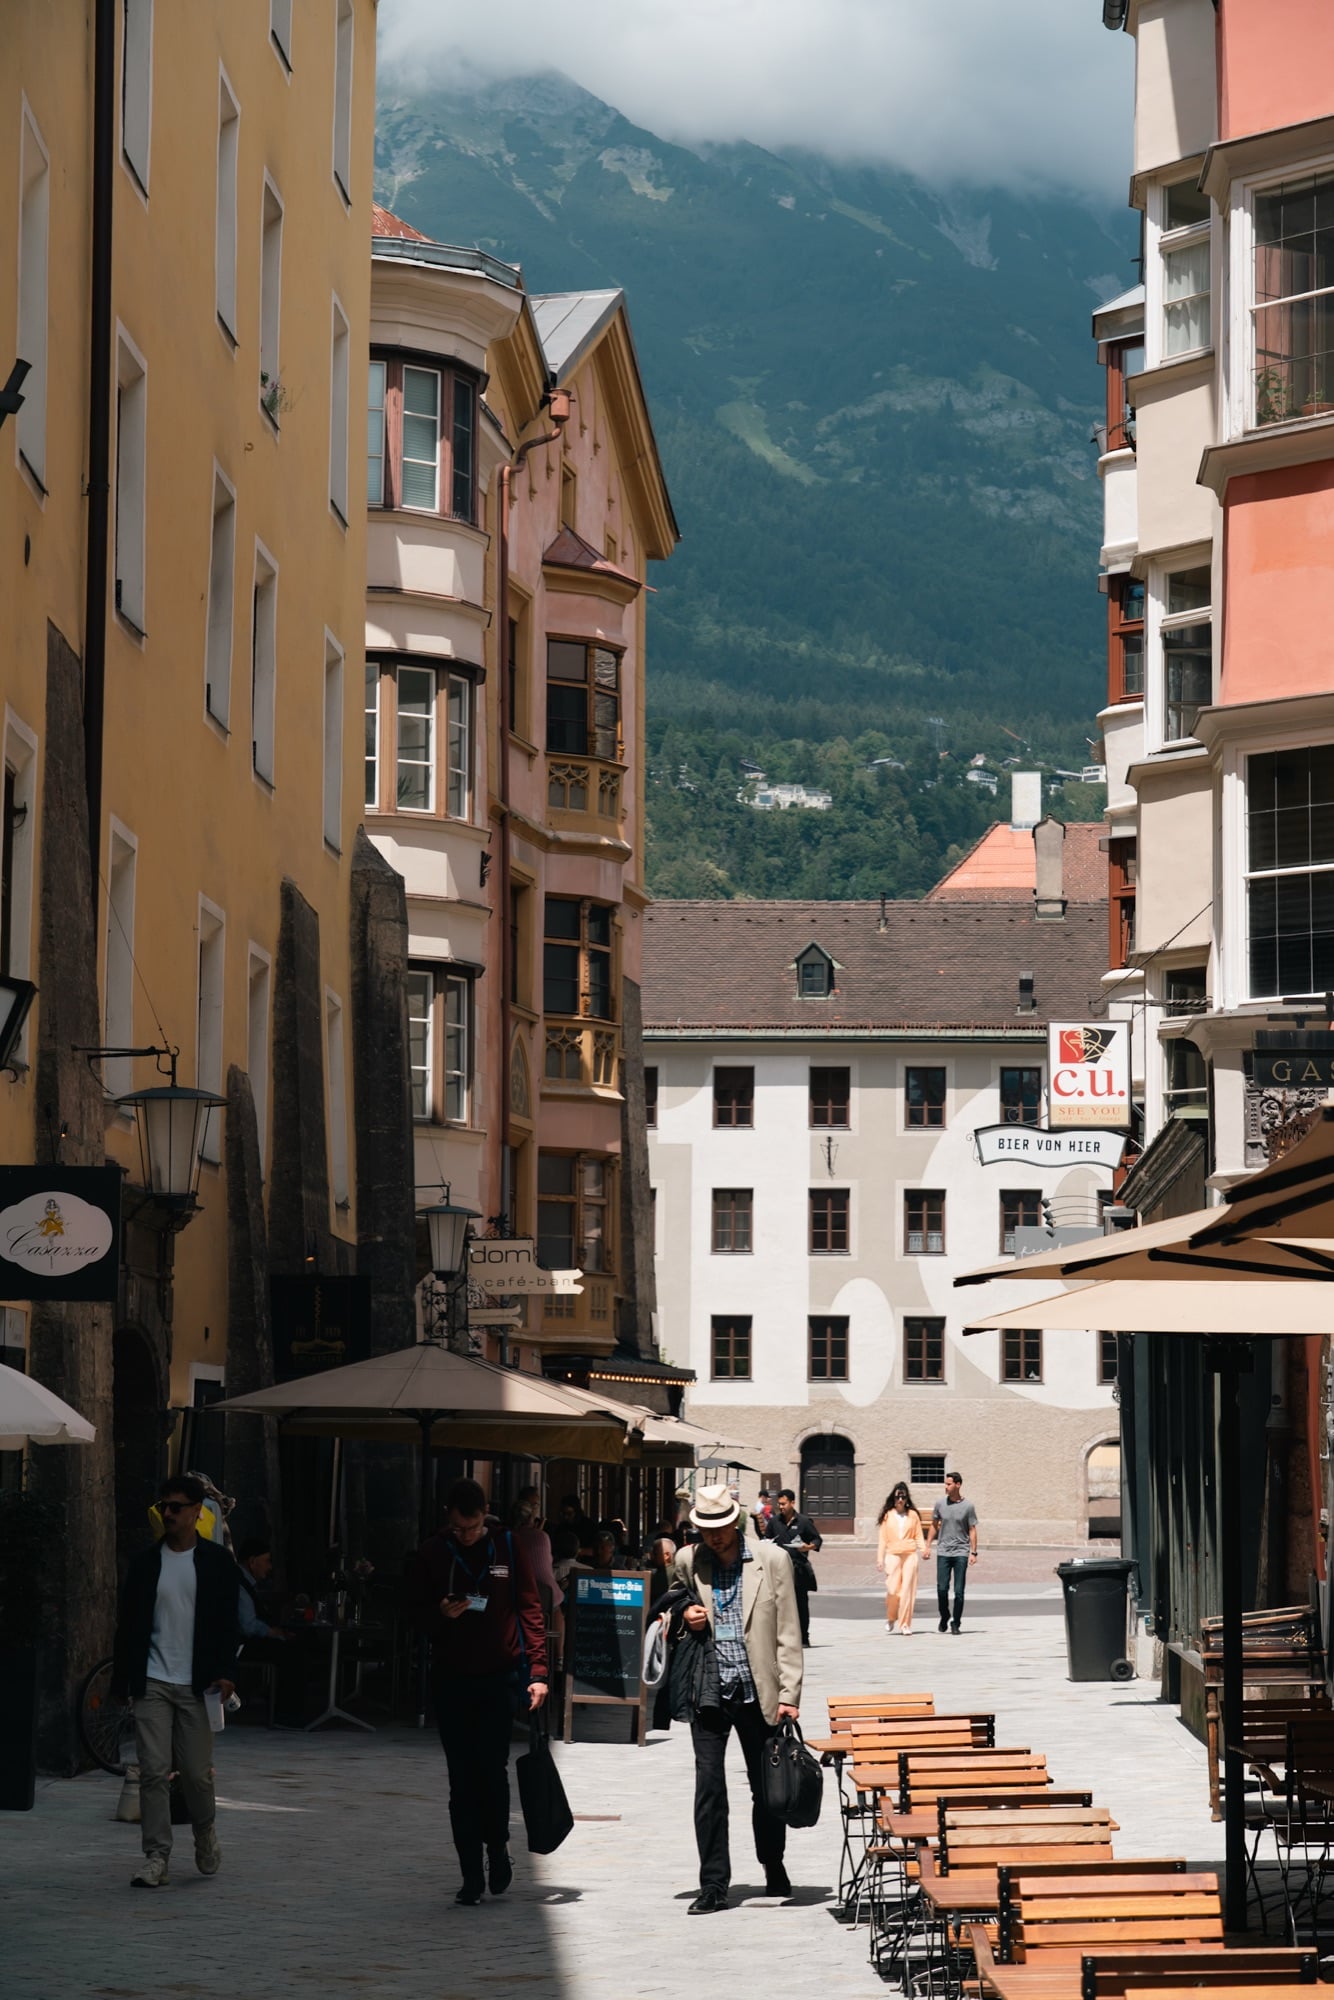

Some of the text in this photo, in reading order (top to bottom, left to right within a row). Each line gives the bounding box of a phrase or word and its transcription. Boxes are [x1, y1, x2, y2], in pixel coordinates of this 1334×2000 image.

[1271, 1060, 1334, 1081] GA
[1059, 1107, 1120, 1115] SEE YOU
[998, 1138, 1101, 1153] BIER VON HIER
[470, 1246, 531, 1264] dom
